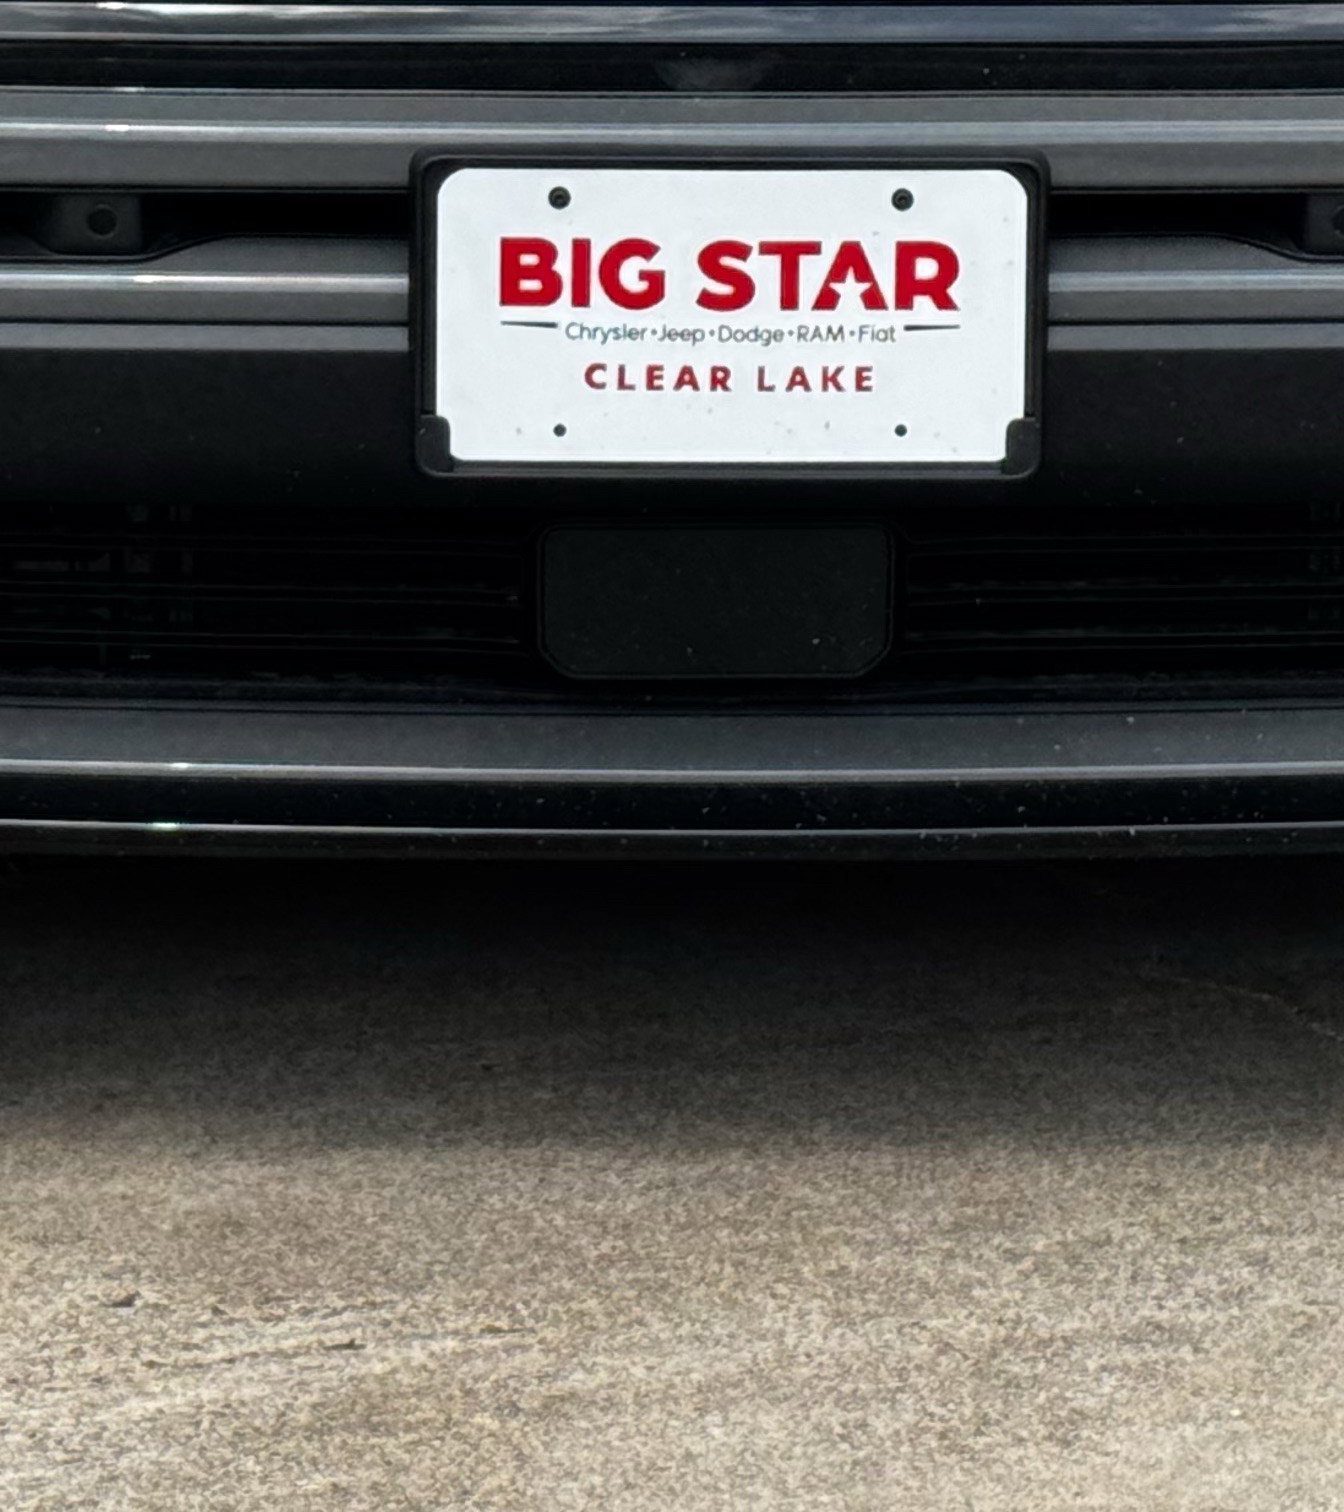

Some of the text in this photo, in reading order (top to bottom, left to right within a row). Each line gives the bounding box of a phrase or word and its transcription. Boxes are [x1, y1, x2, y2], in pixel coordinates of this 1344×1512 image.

[499, 237, 959, 312] BIG STAR
[565, 321, 897, 346] Chrysler Jeep Dodge RAM Fiat
[584, 363, 874, 392] CLEAR LAKE
